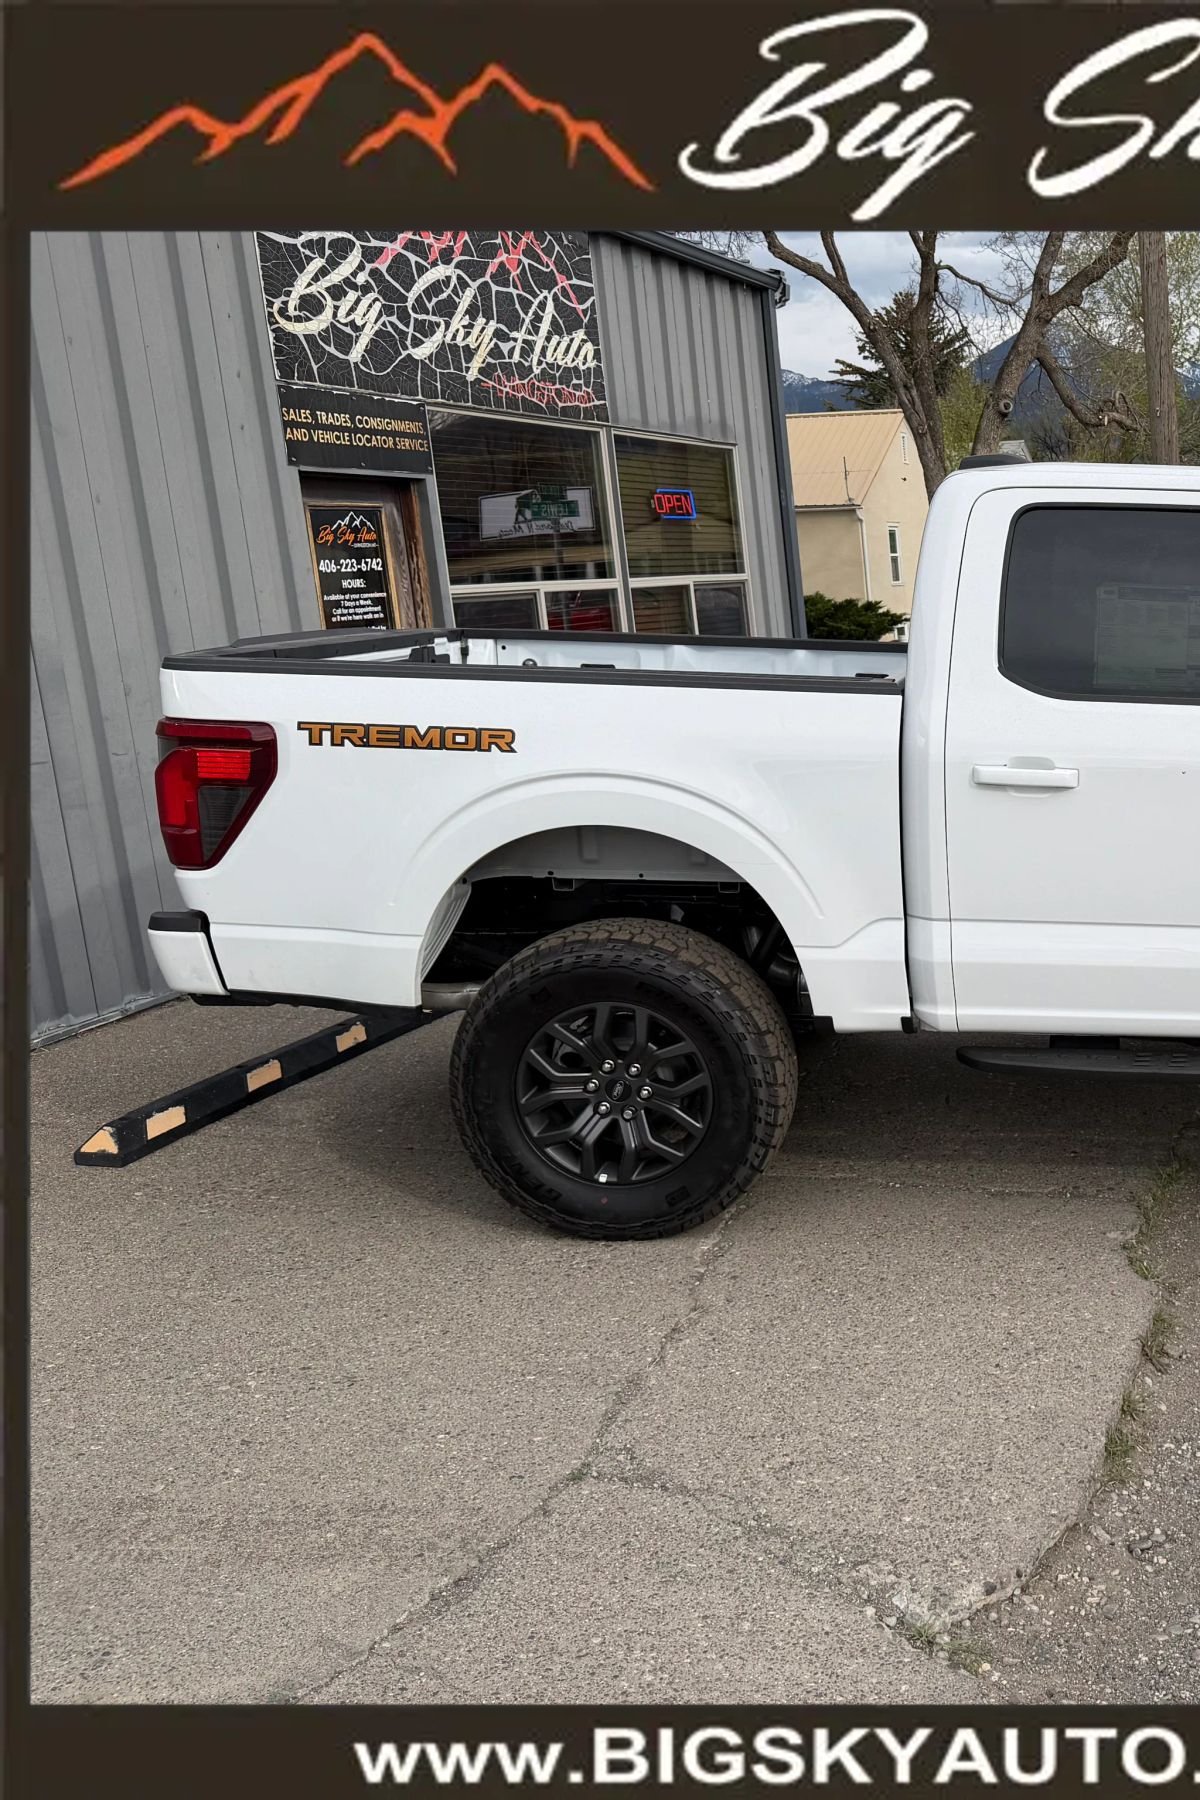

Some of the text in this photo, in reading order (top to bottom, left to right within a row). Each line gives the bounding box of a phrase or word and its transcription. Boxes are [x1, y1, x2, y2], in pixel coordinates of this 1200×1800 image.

[273, 231, 598, 381] Big Sky Auto
[282, 407, 427, 436] SALES, TRADES, CONSIGNMENTS,
[285, 427, 429, 452] AND VEHICLE LOCATOR SERVICE
[653, 493, 693, 514] OPEN
[316, 525, 377, 546] Big Sky Auto
[319, 558, 383, 573] 406-223-6742
[342, 579, 367, 589] HOURS:
[297, 721, 518, 754] TREMOR
